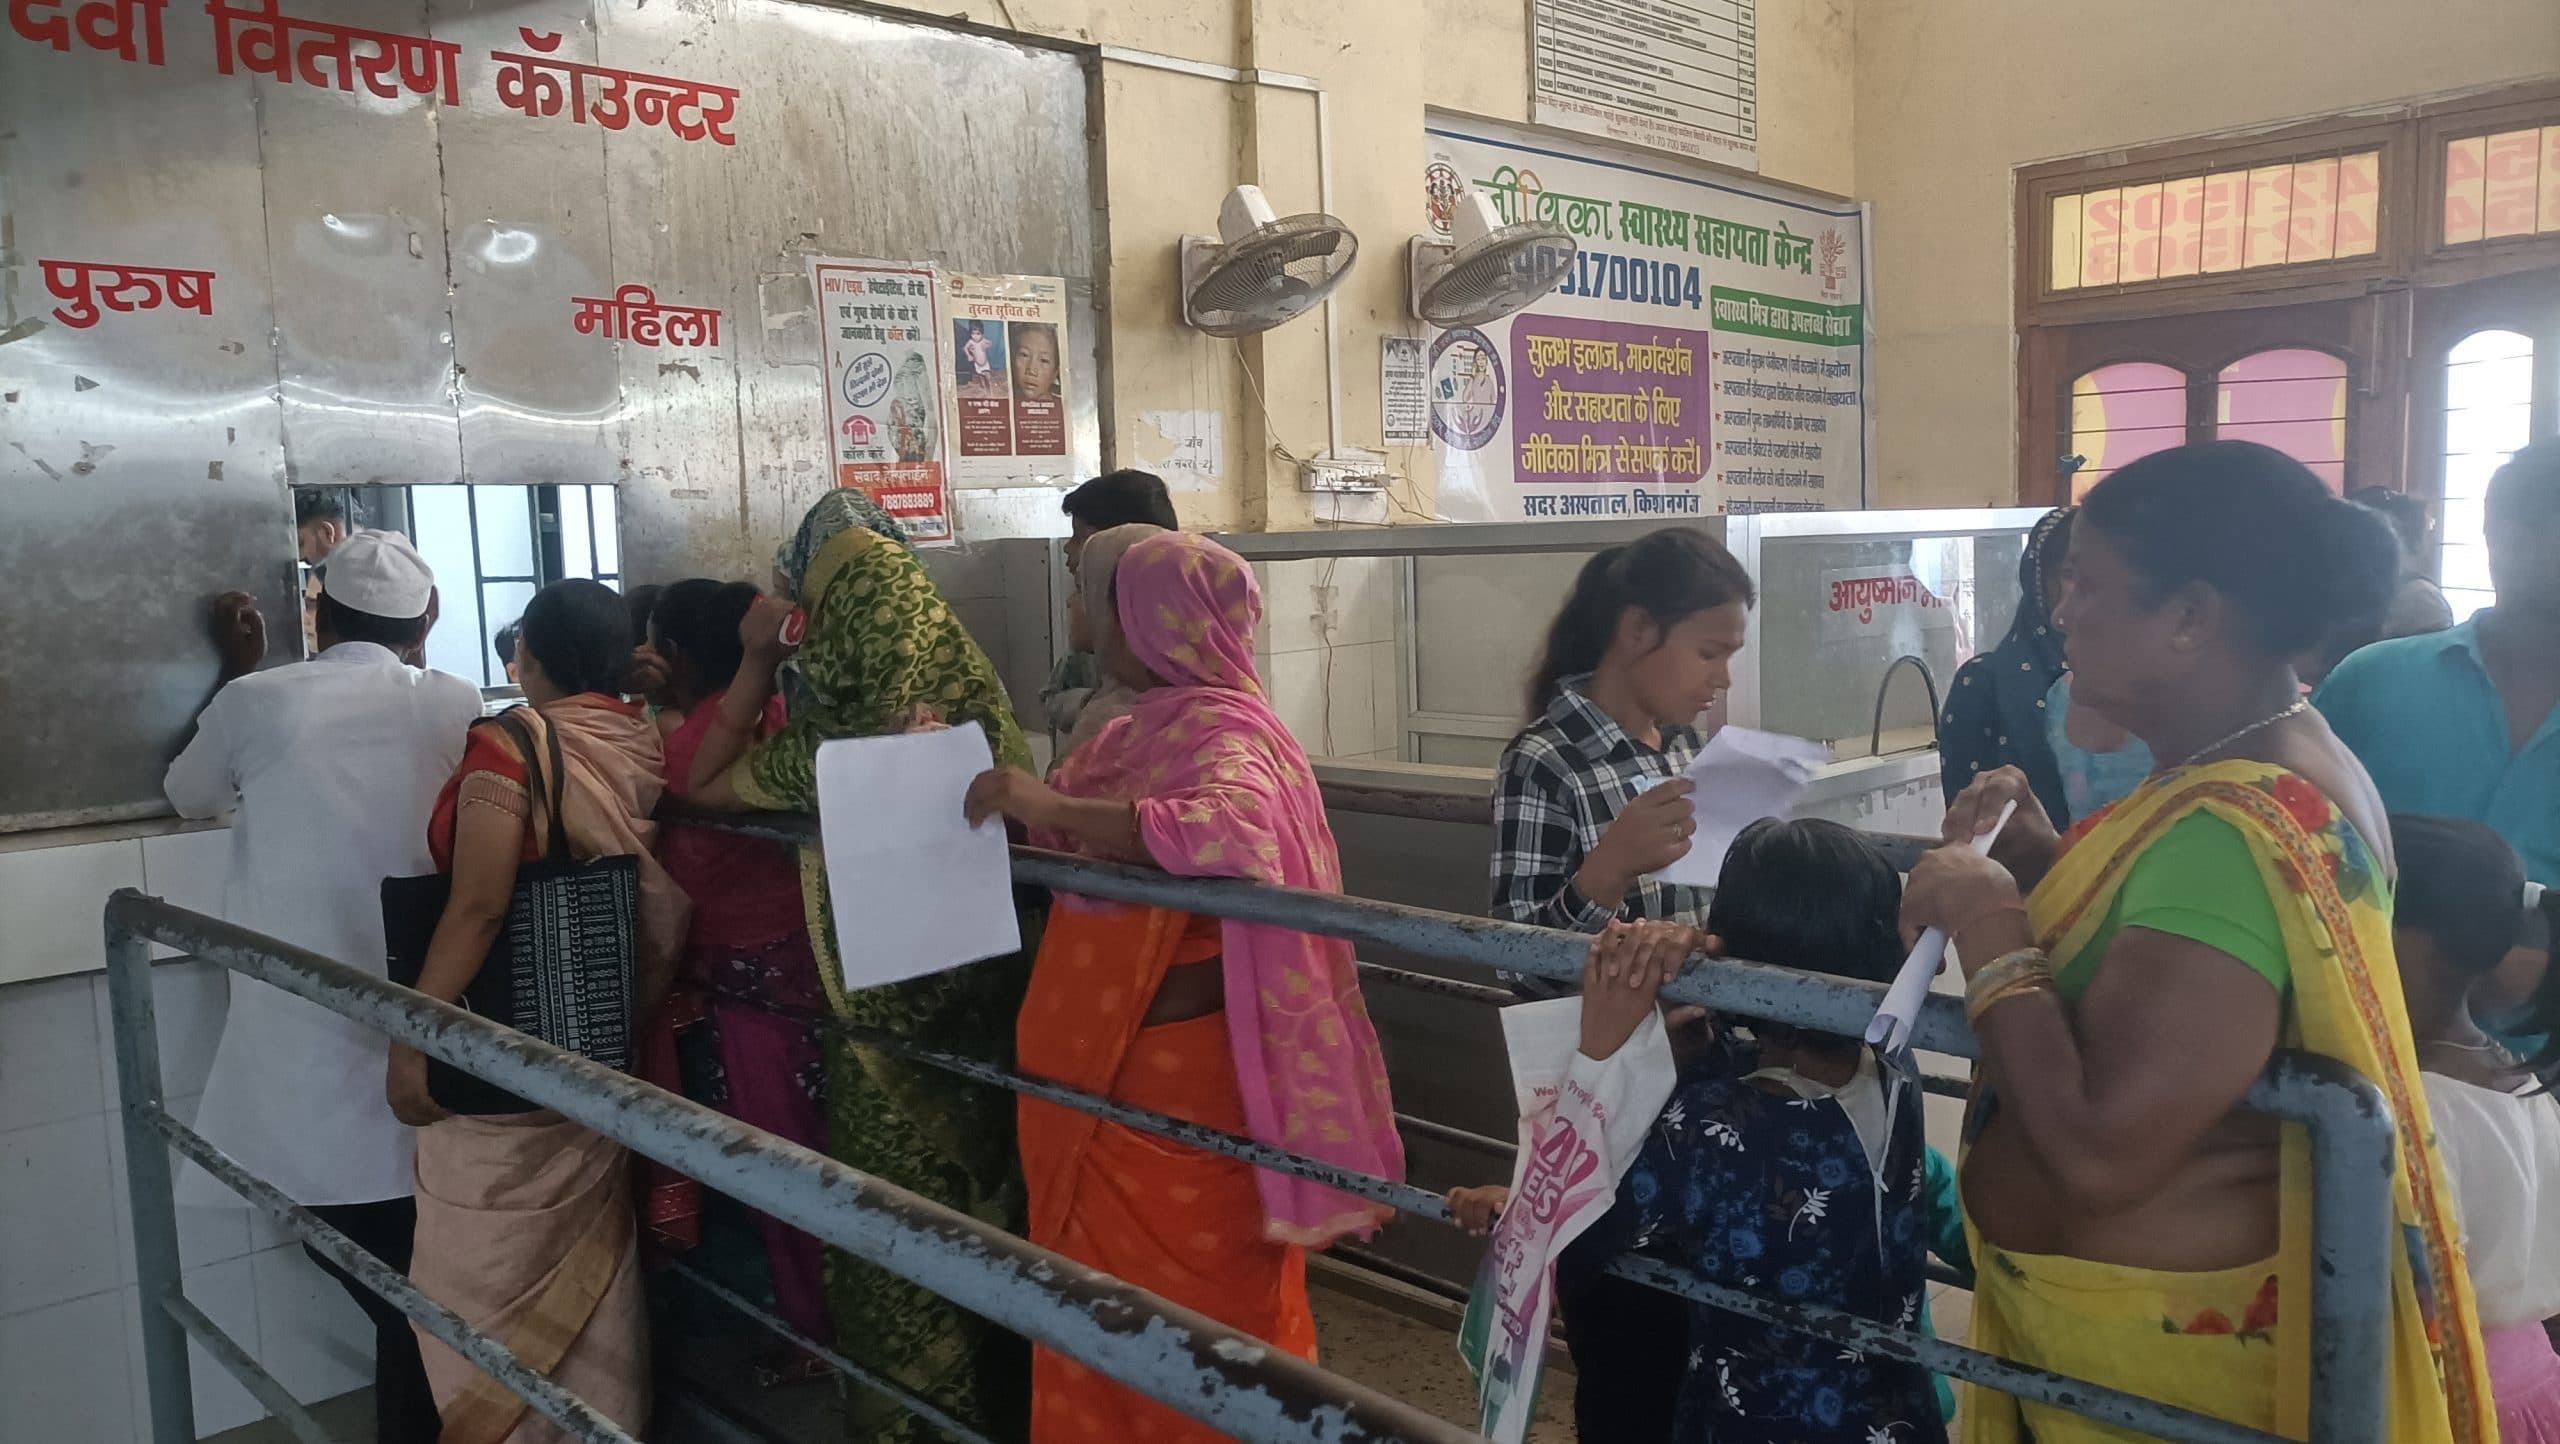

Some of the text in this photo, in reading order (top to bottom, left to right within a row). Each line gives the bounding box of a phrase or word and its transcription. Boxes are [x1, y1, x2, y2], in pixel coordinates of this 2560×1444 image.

[205, 0, 461, 106] वितरण
[1619, 200, 1690, 252] स्वास्थ्य
[1694, 214, 1770, 267] सहायता
[1774, 220, 1814, 275] केन्द्र
[39, 258, 216, 329] पुरुष
[571, 283, 722, 347] महिला
[996, 303, 1024, 319] सूचित
[1526, 334, 1693, 378] सुलभ इलाज, मार्गदर्शन
[1544, 380, 1681, 427] और सहायता के लिए
[842, 446, 866, 461] कॉल
[853, 466, 881, 484] संवाद
[1521, 433, 1580, 474] जीविका
[1581, 434, 1612, 473] मित्र
[1615, 436, 1630, 474] से
[1630, 435, 1669, 474] संपर्क
[1523, 495, 1557, 516] सदर
[1830, 576, 1917, 625] आयुष्मान
